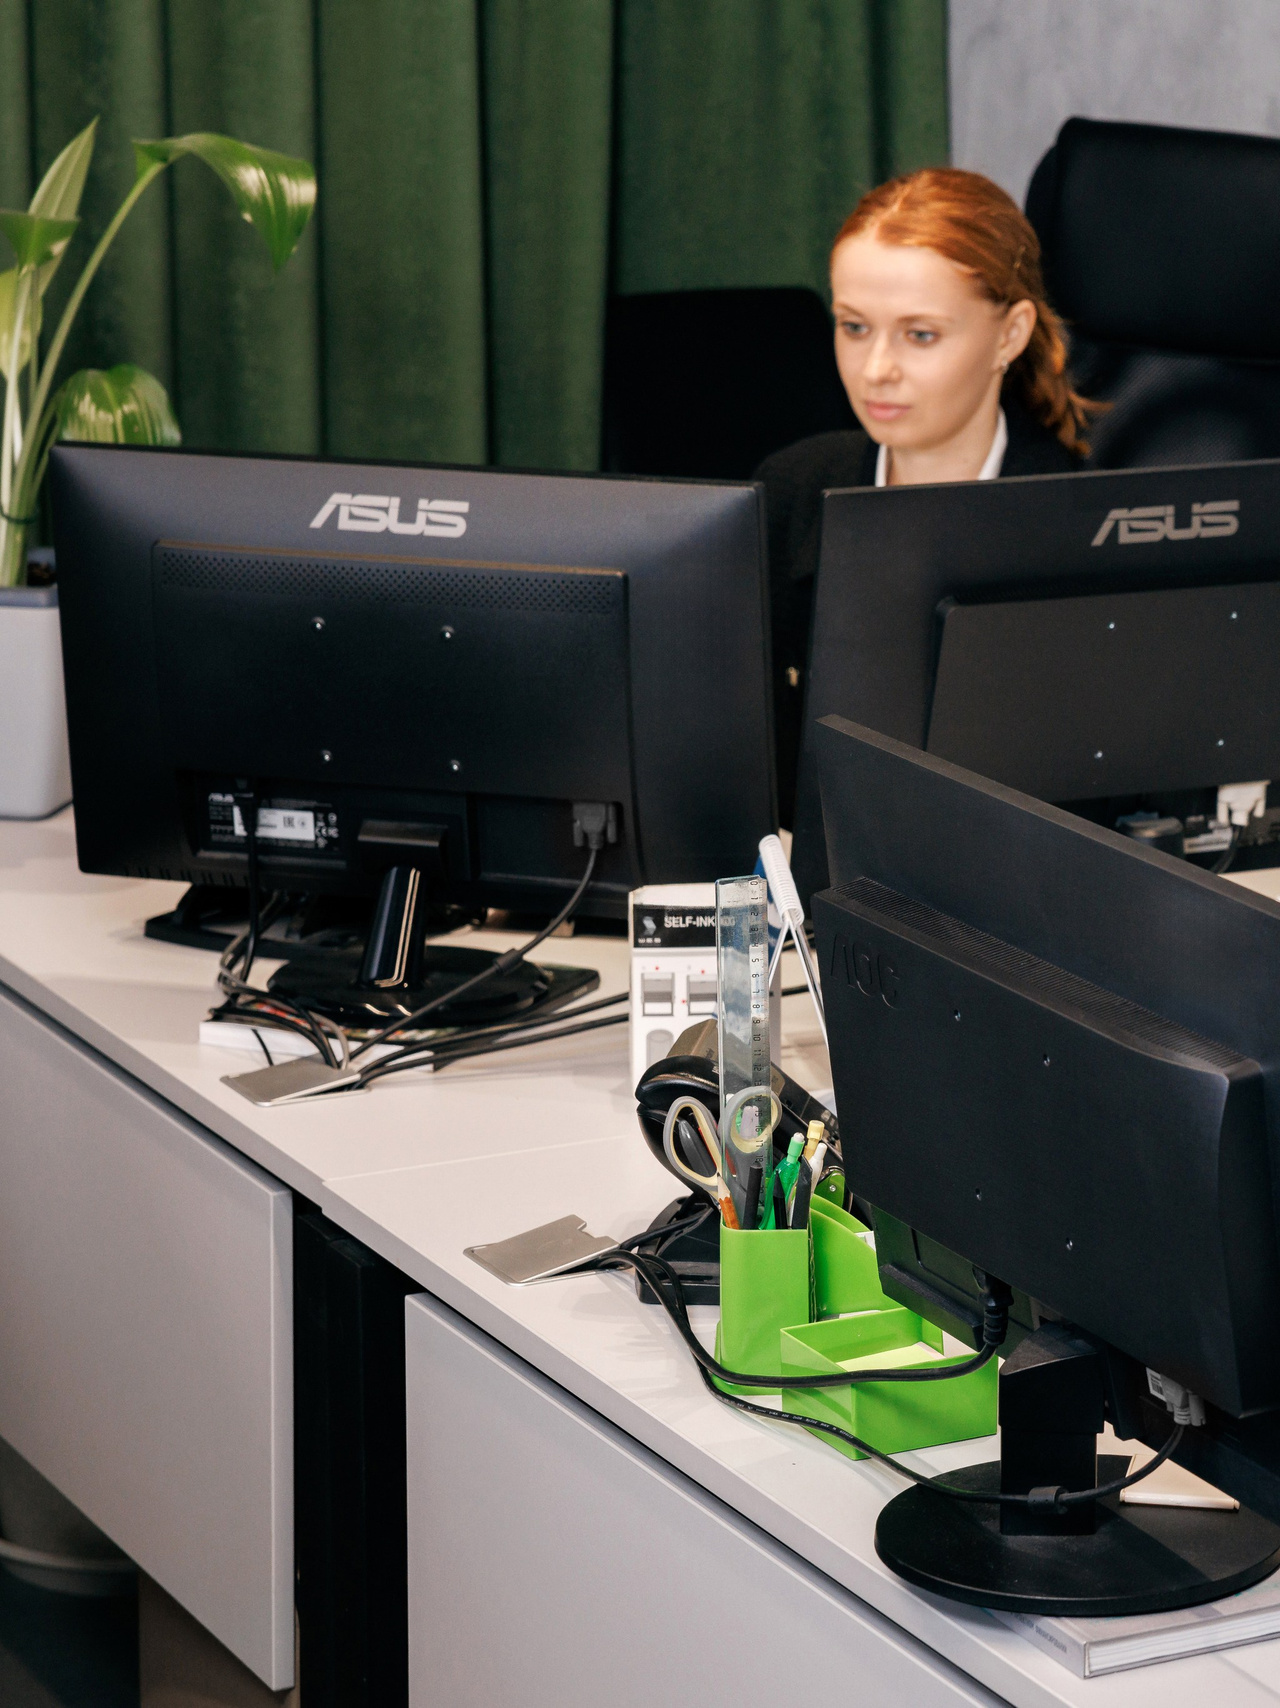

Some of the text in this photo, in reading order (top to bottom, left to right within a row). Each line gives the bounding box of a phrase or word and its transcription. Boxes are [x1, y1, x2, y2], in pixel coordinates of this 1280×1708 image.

[309, 492, 470, 538] ASUS
[1091, 500, 1240, 547] ASUS
[664, 914, 736, 928] SELF-INK
[753, 1033, 761, 1042] 10
[753, 1063, 762, 1072] 12
